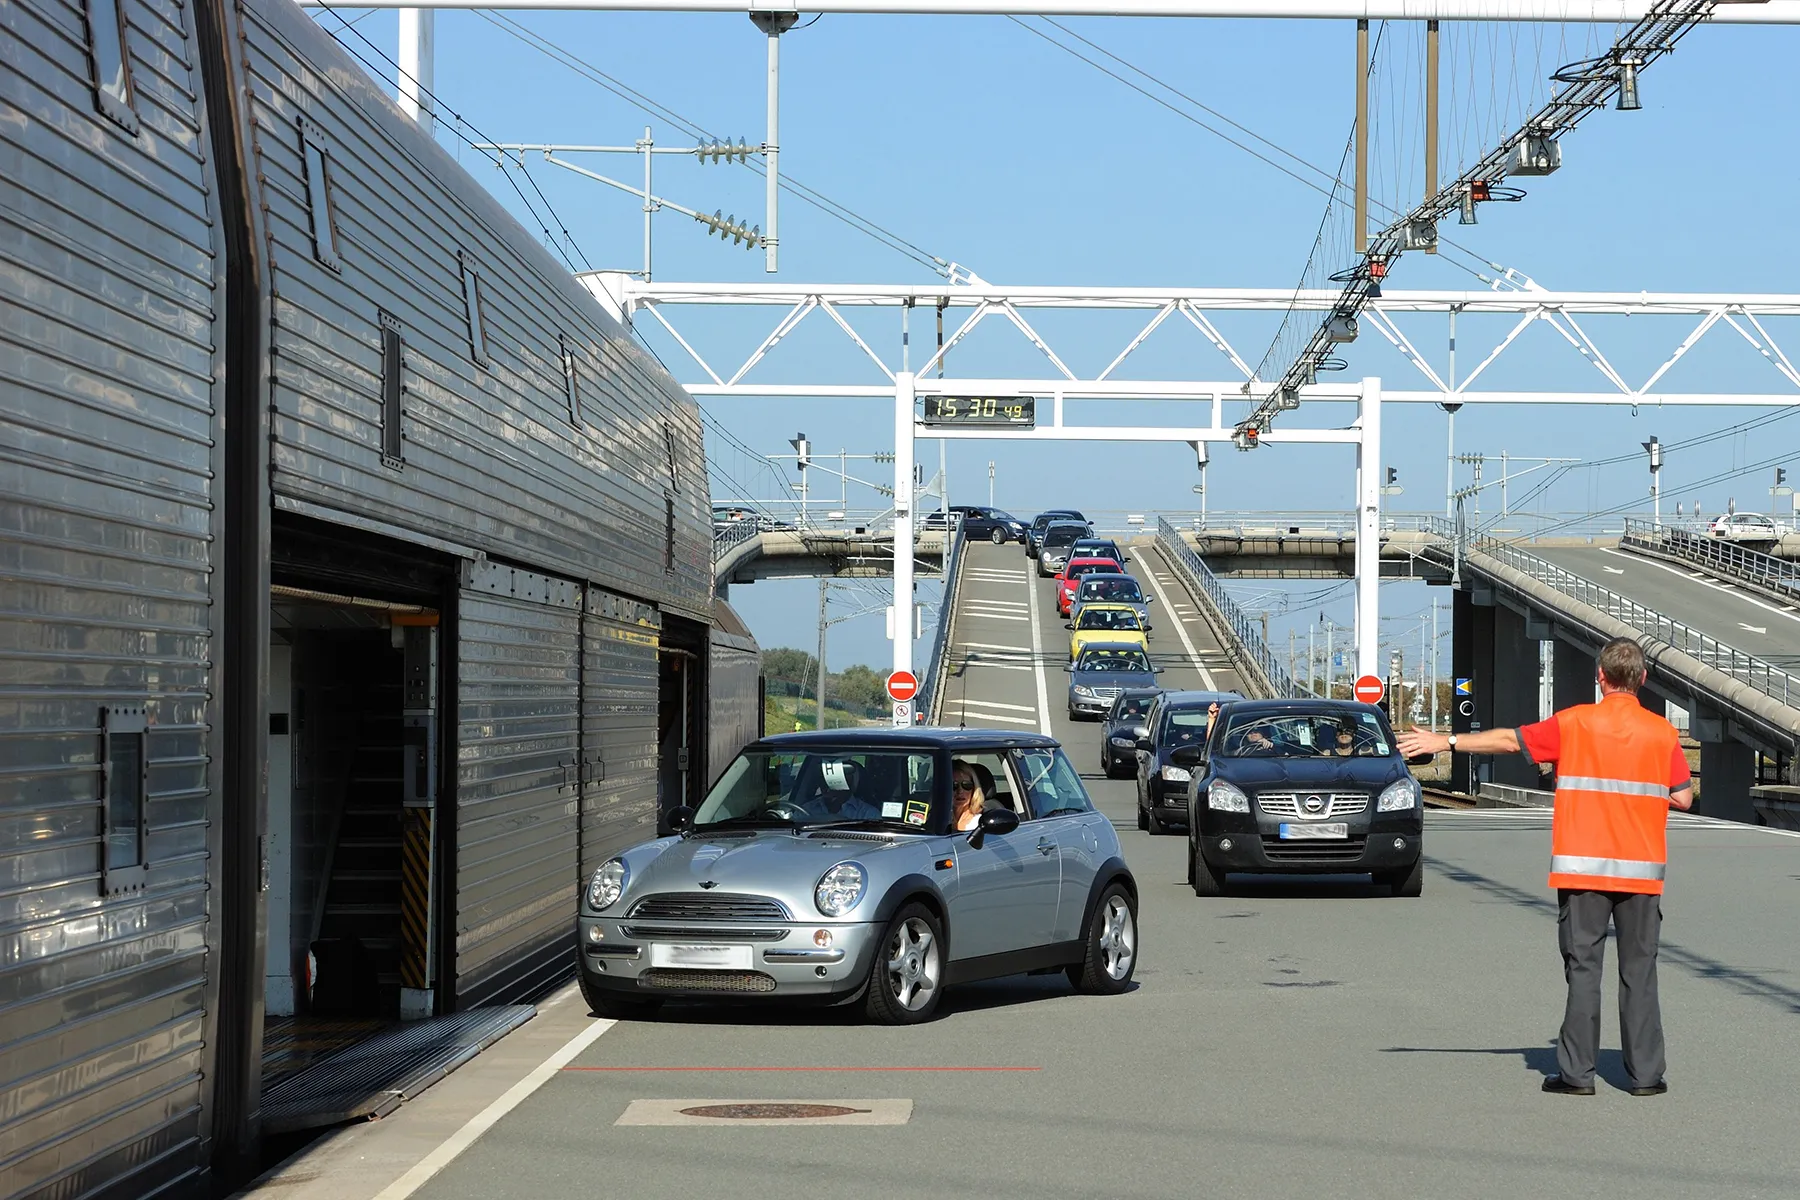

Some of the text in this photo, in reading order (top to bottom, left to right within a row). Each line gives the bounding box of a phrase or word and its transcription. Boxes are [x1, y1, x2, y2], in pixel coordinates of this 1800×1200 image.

[937, 399, 1022, 417] 15 30 49
[825, 762, 834, 775] H
